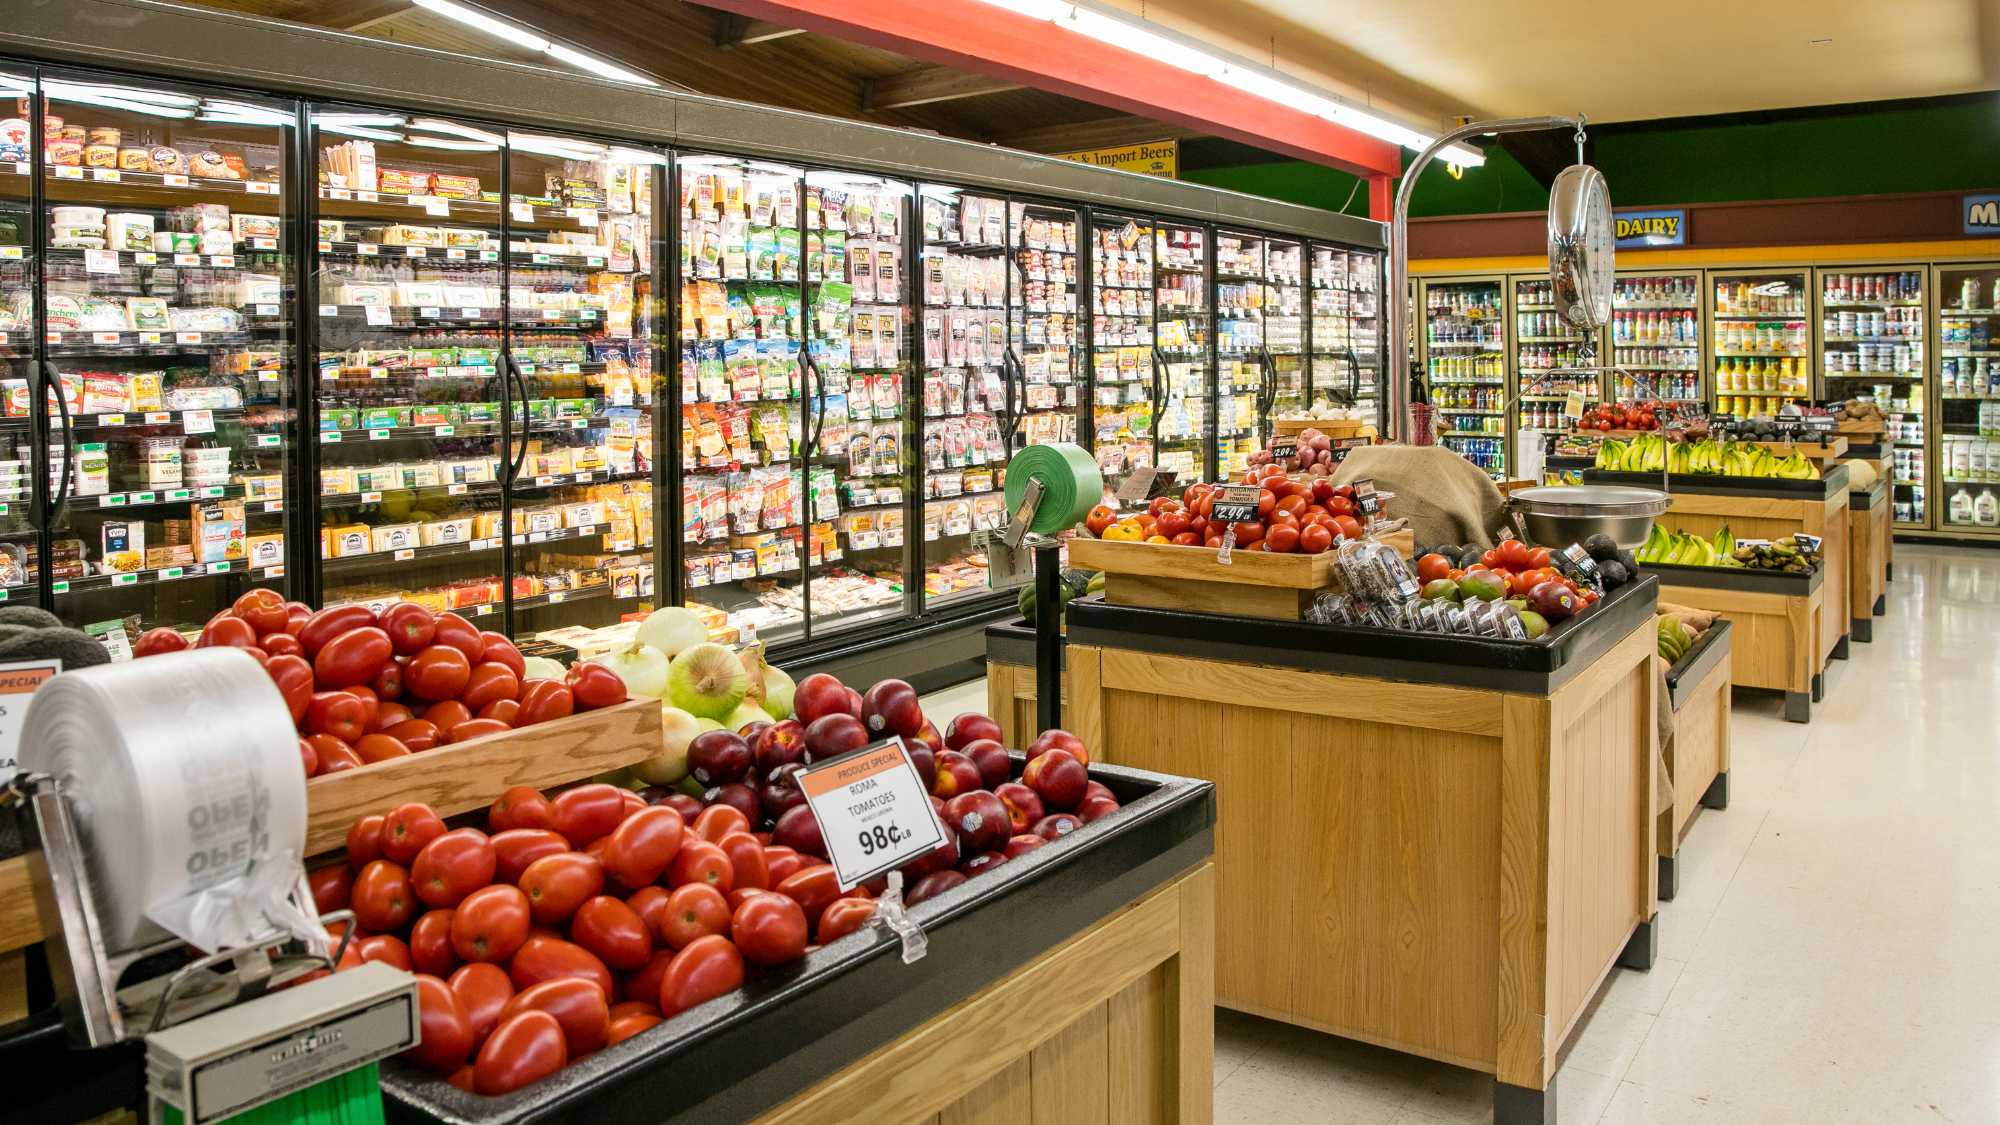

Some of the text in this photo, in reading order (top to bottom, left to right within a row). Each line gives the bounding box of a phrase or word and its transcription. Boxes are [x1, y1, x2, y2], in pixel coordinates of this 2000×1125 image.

[1094, 150, 1136, 166] Import
[1140, 146, 1174, 160] Beers
[1968, 200, 2000, 226] M
[1615, 216, 1679, 240] DAIRY
[0, 677, 42, 687] PECIAL
[838, 753, 897, 780] PRODUCE SPECIAL
[849, 778, 879, 796] ROMA
[848, 791, 896, 817] TOMATOES
[859, 820, 912, 855] 98¢ LB
